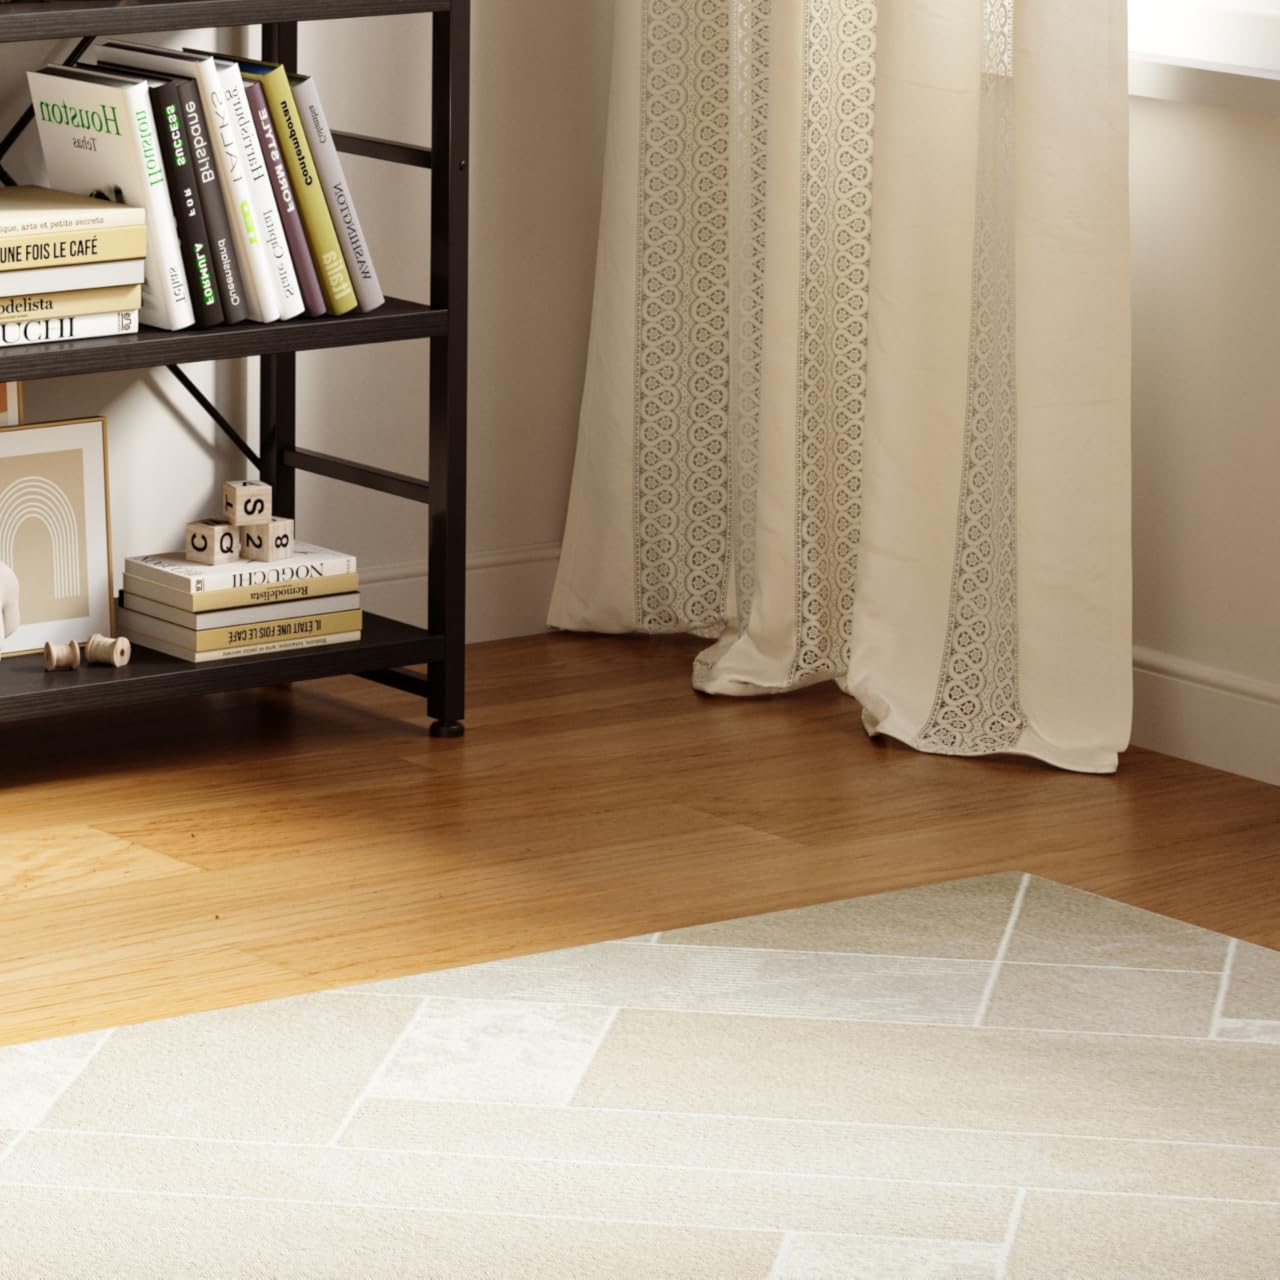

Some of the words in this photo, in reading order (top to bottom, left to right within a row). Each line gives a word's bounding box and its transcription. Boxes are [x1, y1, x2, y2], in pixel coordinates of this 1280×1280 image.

[0, 246, 22, 264] UNE
[25, 243, 50, 261] FOIS
[53, 241, 66, 258] LE
[70, 235, 98, 256] CAFÉ
[244, 498, 264, 515] S
[220, 532, 233, 555] Q
[246, 533, 263, 549] 2
[274, 534, 289, 549] 8
[232, 562, 324, 588] NOGUCHI
[250, 585, 308, 600] Remodelista
[249, 628, 258, 639] LE
[259, 626, 275, 638] FOIS
[277, 623, 292, 635] UNE
[228, 630, 247, 644] CAFÉ
